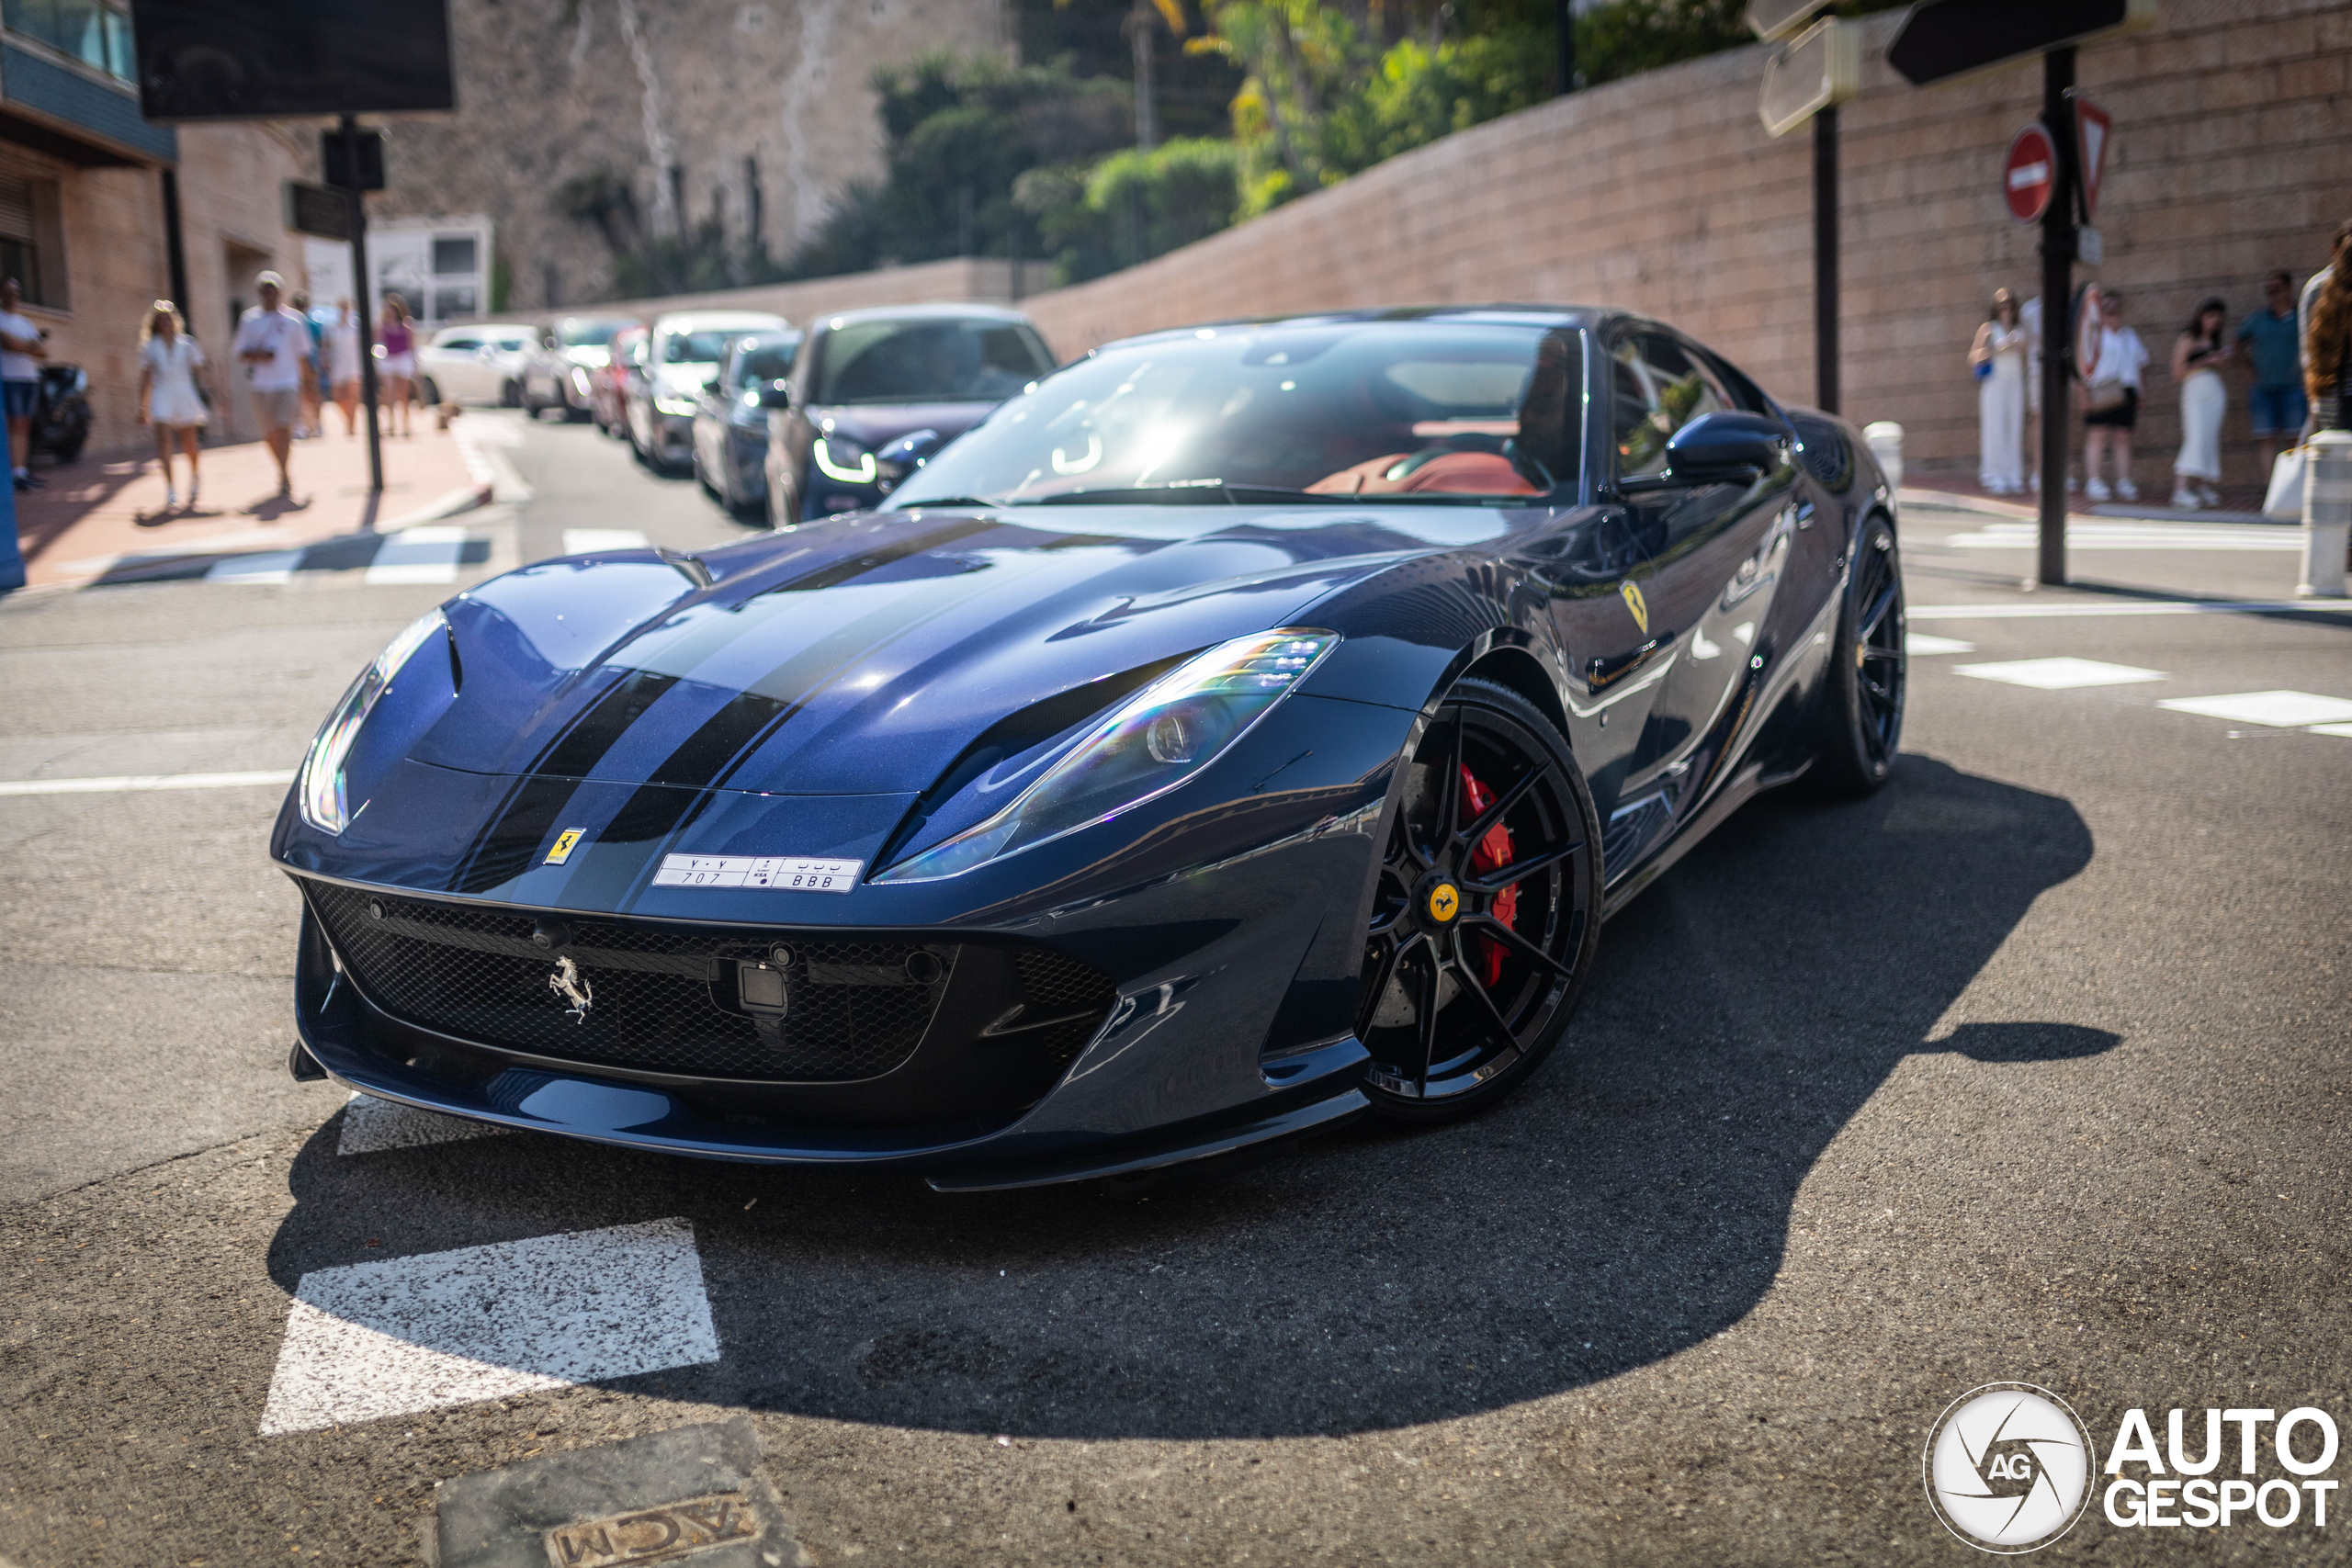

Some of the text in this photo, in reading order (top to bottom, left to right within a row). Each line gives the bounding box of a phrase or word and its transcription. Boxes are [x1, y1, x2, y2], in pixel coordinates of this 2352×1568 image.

[682, 873, 720, 884] 707
[792, 875, 832, 887] BBB
[560, 1501, 732, 1564] ACM
